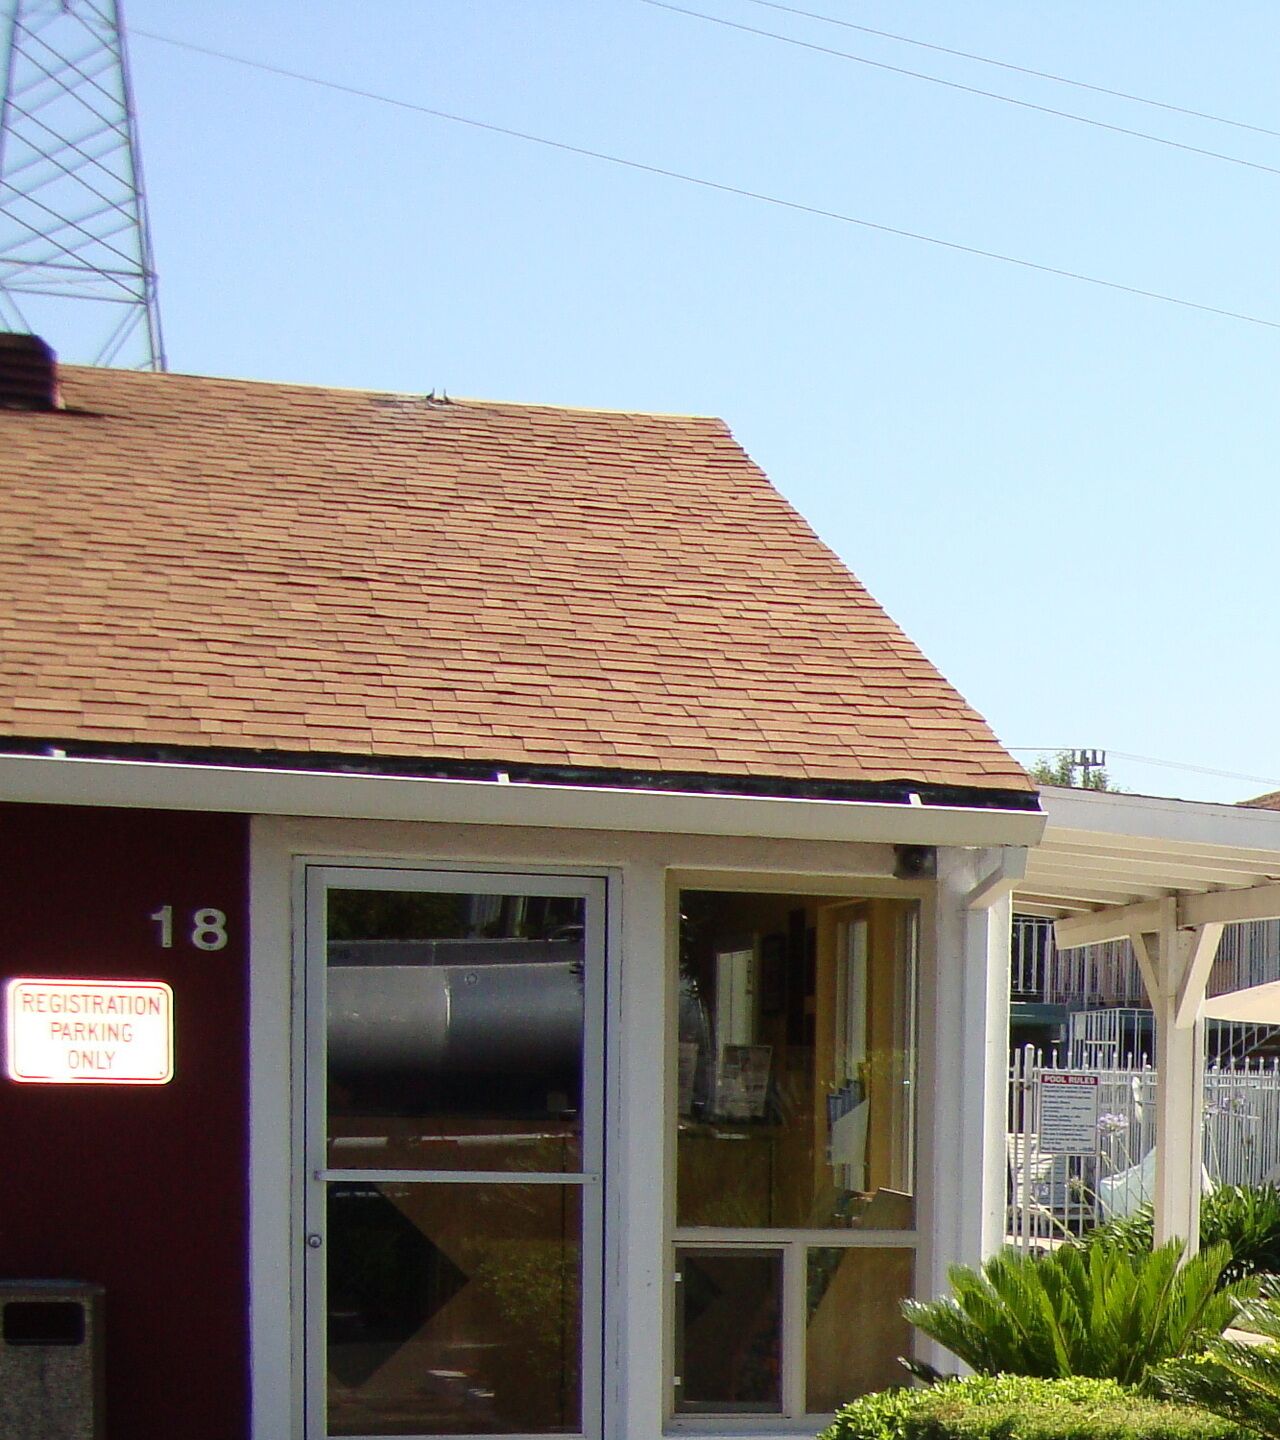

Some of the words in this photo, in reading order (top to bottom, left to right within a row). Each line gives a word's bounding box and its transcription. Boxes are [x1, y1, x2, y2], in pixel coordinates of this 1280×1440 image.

[151, 905, 229, 950] 18
[22, 993, 161, 1016] REGISTRATION
[50, 1022, 133, 1043] PARKING
[67, 1050, 116, 1070] ONLY
[1044, 1075, 1067, 1084] POOL
[1068, 1076, 1095, 1085] RULES
